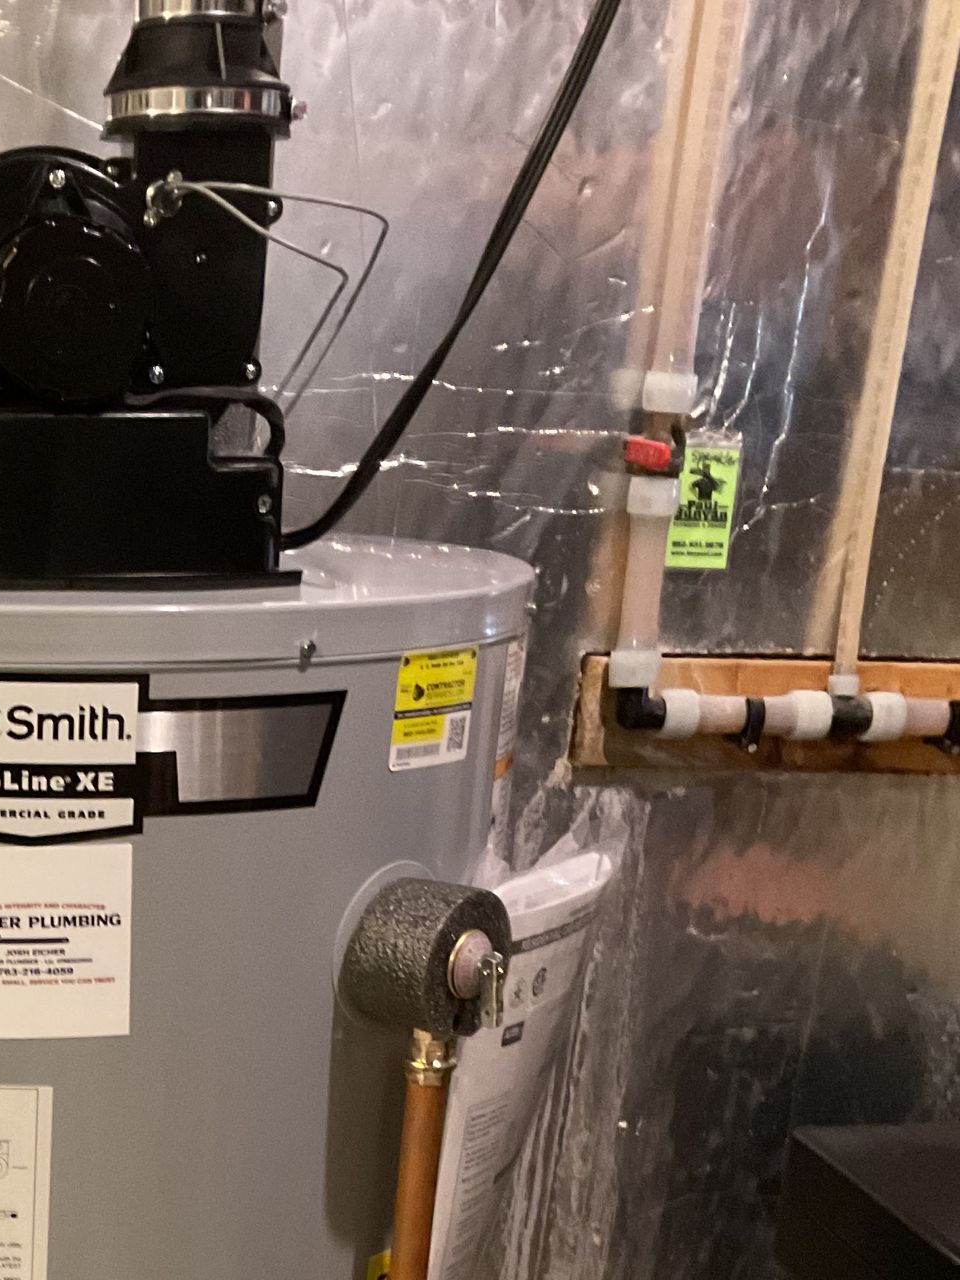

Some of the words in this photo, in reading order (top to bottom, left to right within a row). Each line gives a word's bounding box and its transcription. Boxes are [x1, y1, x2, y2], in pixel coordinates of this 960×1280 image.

[76, 772, 115, 793] XE
[58, 807, 106, 821] GRADE
[29, 913, 121, 928] PLUMBING
